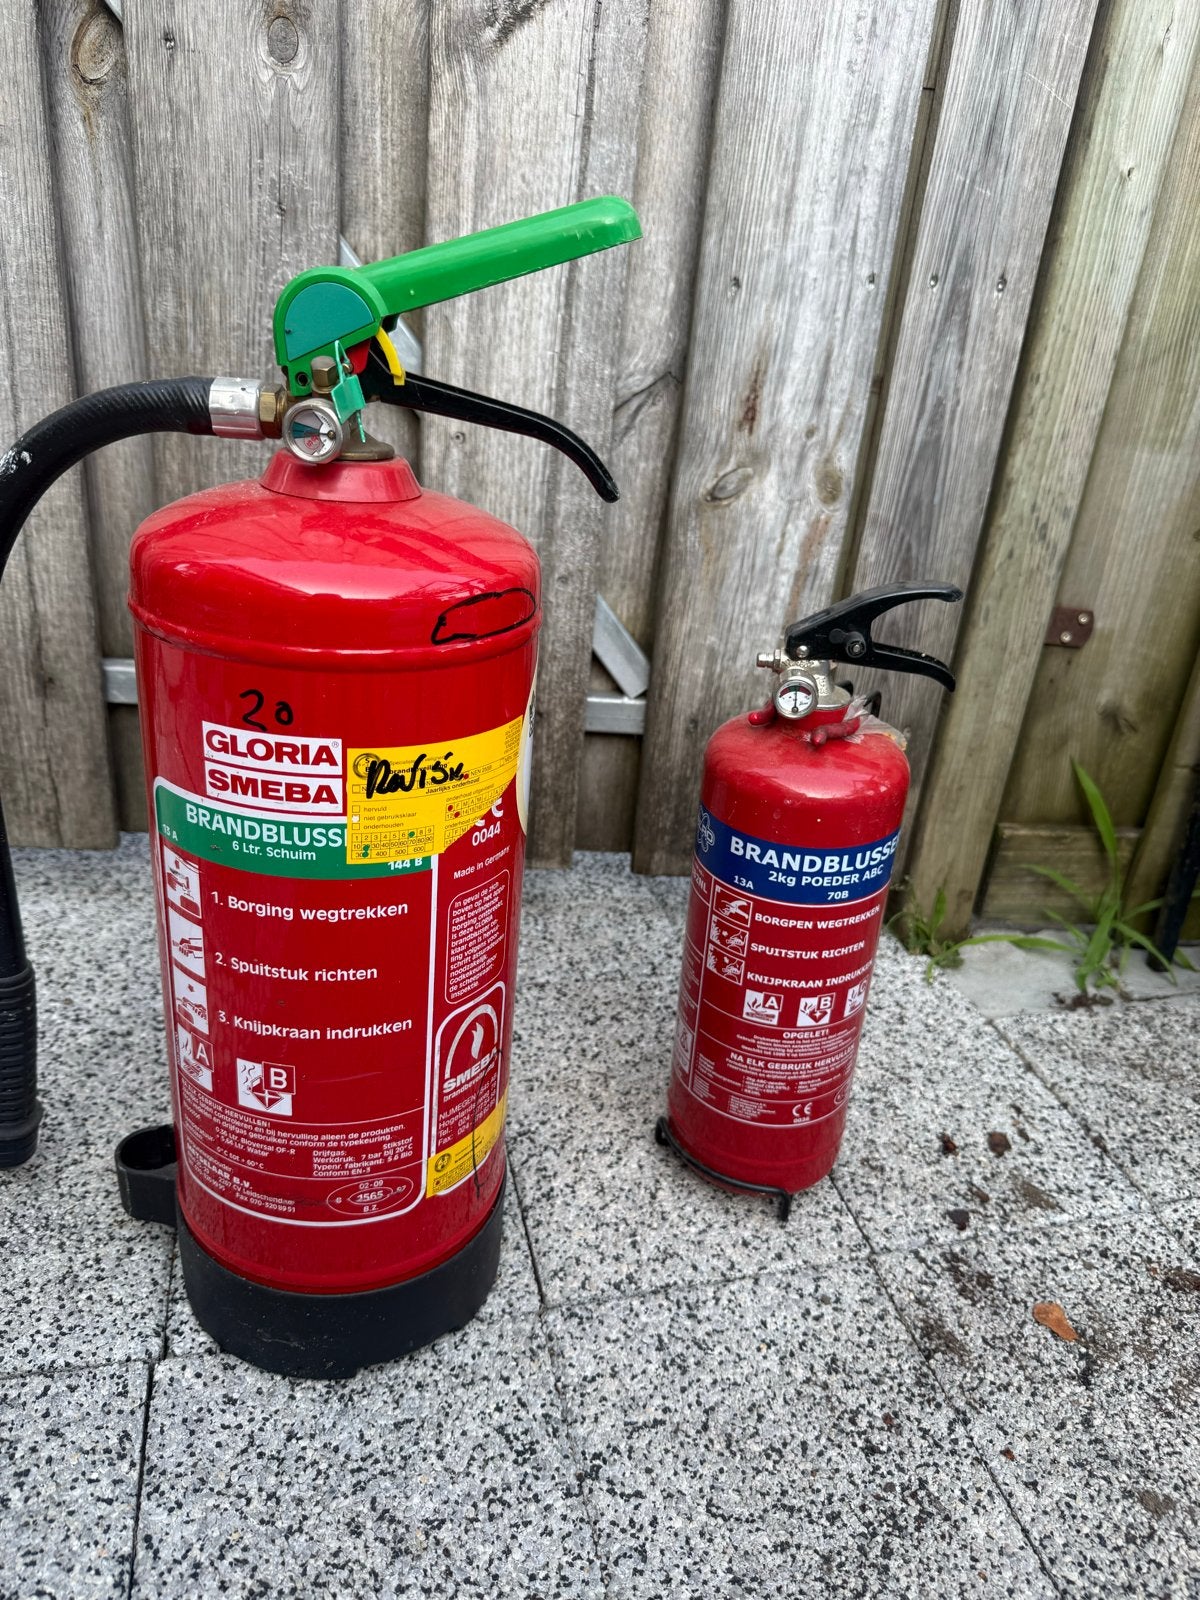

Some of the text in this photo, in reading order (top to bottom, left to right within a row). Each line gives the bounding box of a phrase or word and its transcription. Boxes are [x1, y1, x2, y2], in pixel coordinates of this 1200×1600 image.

[205, 729, 339, 767] GLORIA
[208, 768, 339, 805] SMEBA
[425, 784, 451, 795] Jaarlijks
[186, 802, 347, 848] BRANDBLUSS
[363, 822, 404, 830] onderhouden
[376, 812, 417, 822] gebruiksklaar
[472, 821, 500, 846] 0044
[232, 841, 317, 861] 6 Ltr. Schuim
[387, 857, 423, 870] 144 B
[453, 845, 511, 879] Made in Germany
[733, 875, 755, 890] 13A
[768, 864, 884, 887] 2kg POEDER ABC
[827, 890, 849, 900] 70B
[211, 891, 409, 923] 1. Borging wegtrekken
[754, 904, 880, 930] BORGPEN WEGTREKKEN
[750, 940, 865, 960] SPUITSTUK RICHTEN
[214, 952, 378, 982] 2. Spuitstuk richten
[746, 959, 873, 989] KNIJPKRAAN INDRUKKEN
[764, 996, 779, 1010] A
[819, 996, 831, 1009] B
[217, 1010, 412, 1040] 3. Knijpkraan indrukken
[782, 1028, 830, 1040] OPGELET!
[196, 1043, 210, 1066] A
[730, 1052, 744, 1063] NA
[746, 1058, 765, 1068] ELK
[767, 1062, 812, 1071] GEBRUIK
[270, 1067, 288, 1089] B
[443, 1046, 498, 1093] SMEBA
[224, 1109, 271, 1128] HERVULLEN!
[222, 1121, 248, 1136] drijfgas
[248, 1132, 288, 1145] gebruiken
[289, 1138, 326, 1147] conform
[327, 1139, 339, 1147] de
[340, 1134, 393, 1147] typekeuring.
[266, 1128, 276, 1138] bij
[277, 1130, 319, 1141] hervulling
[320, 1132, 346, 1140] alleen
[348, 1131, 359, 1139] de
[360, 1124, 406, 1139] produkten.
[246, 1145, 270, 1158] Water
[312, 1136, 413, 1159] Drijfgas: Stikstof
[313, 1156, 356, 1164] Werkdruk:
[367, 1152, 382, 1160] bar
[384, 1149, 394, 1158] bij
[312, 1168, 350, 1177] Conform
[313, 1163, 342, 1172] Typenr.
[344, 1158, 385, 1170] fabrikant:
